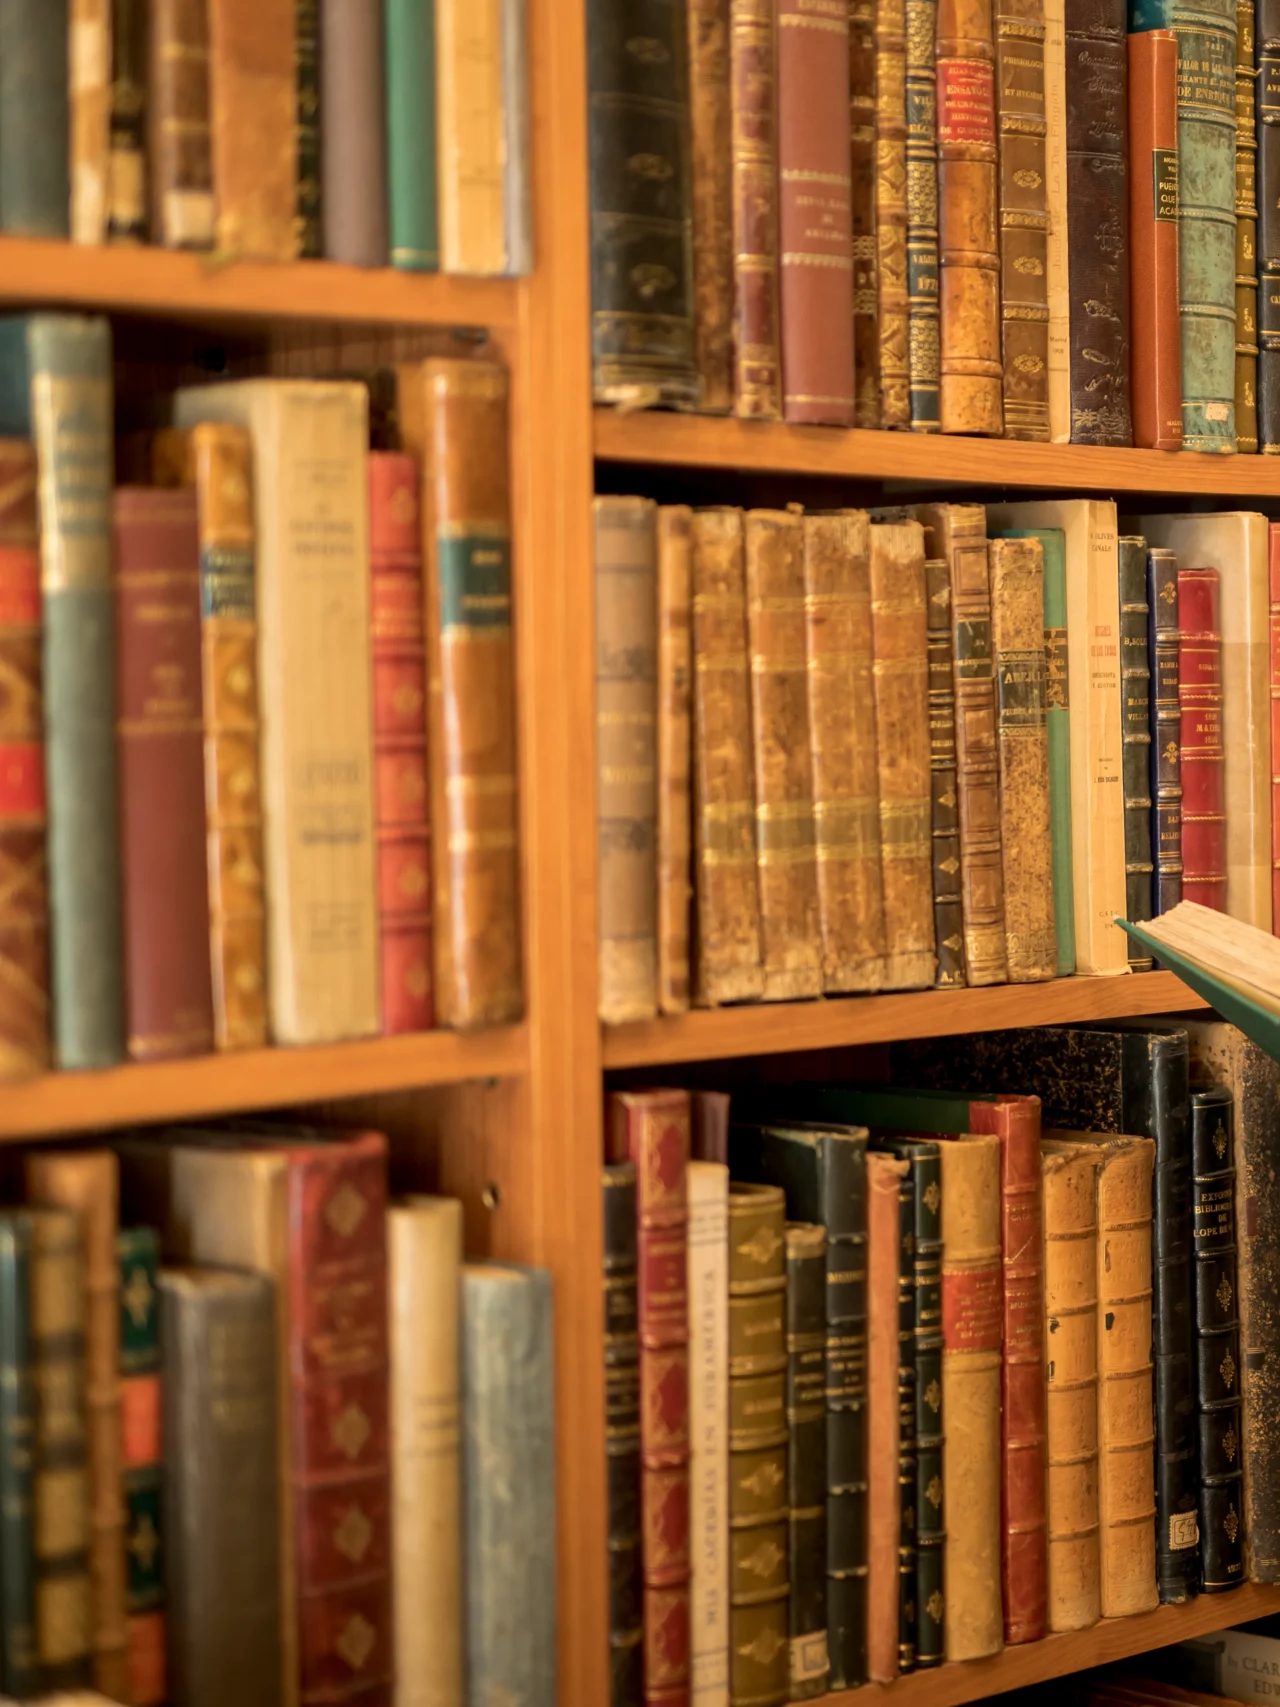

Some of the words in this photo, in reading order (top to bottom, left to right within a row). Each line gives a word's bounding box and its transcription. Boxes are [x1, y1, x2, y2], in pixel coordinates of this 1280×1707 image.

[1177, 86, 1192, 97] DE
[1218, 1213, 1227, 1223] DE
[1193, 1226, 1218, 1238] LOPE
